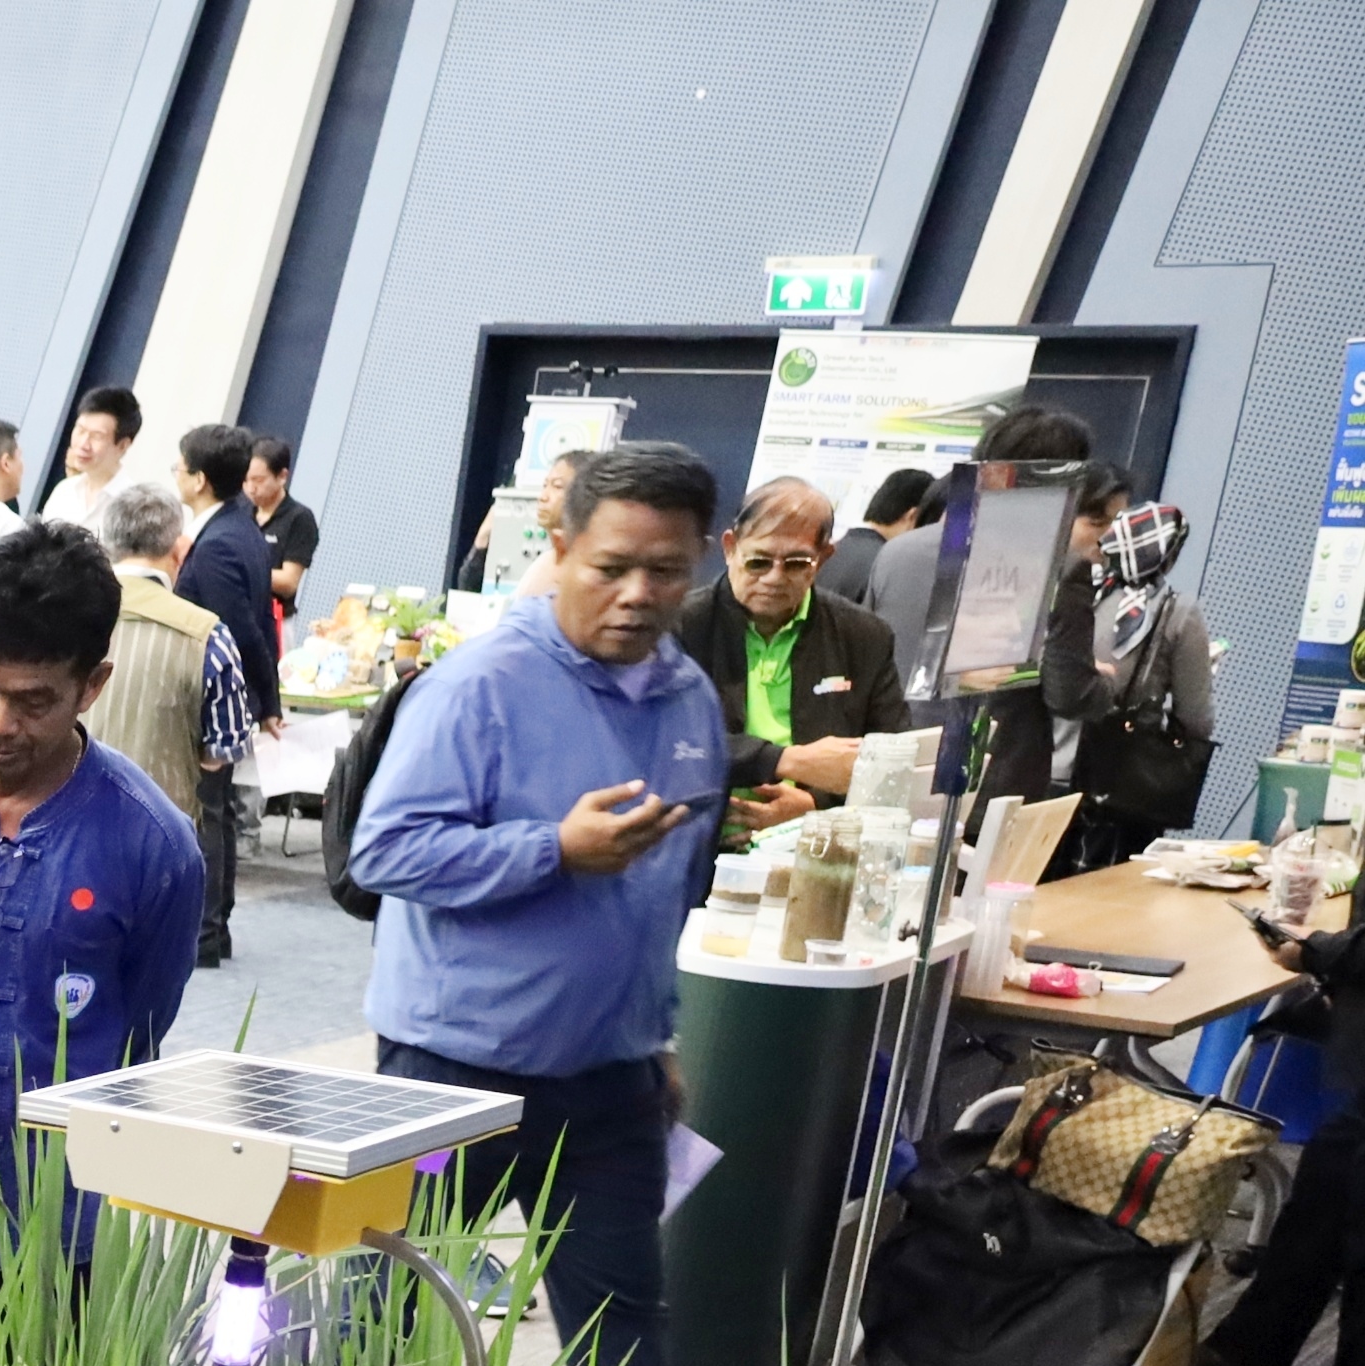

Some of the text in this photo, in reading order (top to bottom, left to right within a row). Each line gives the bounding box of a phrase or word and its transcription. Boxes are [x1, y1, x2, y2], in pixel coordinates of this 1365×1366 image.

[772, 391, 929, 408] SMART FARM SOLUTIONS
